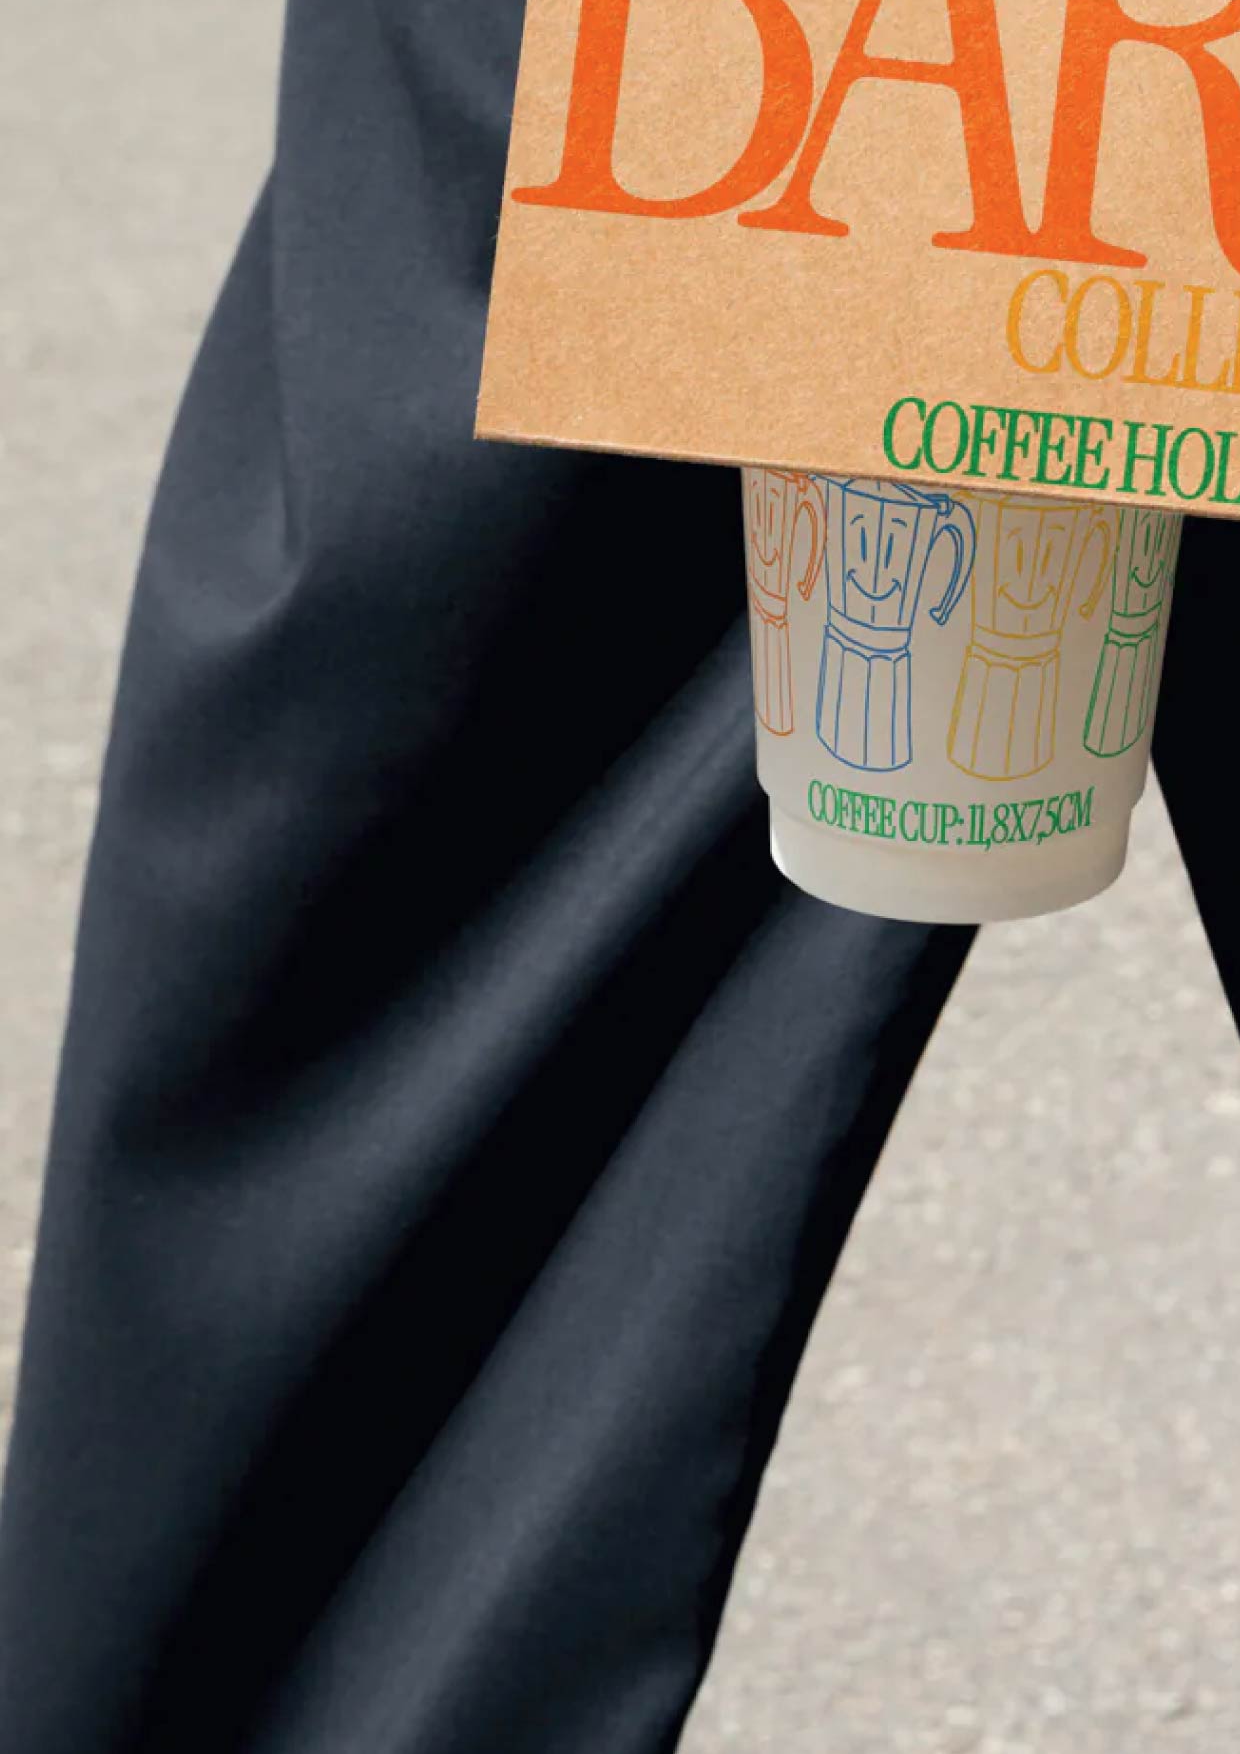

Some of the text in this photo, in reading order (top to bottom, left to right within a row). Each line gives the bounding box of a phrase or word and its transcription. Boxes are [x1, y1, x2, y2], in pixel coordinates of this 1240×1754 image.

[882, 396, 1114, 490] COFFEE
[807, 779, 1096, 852] COFFEE CUP: 11,8X7,5CM
